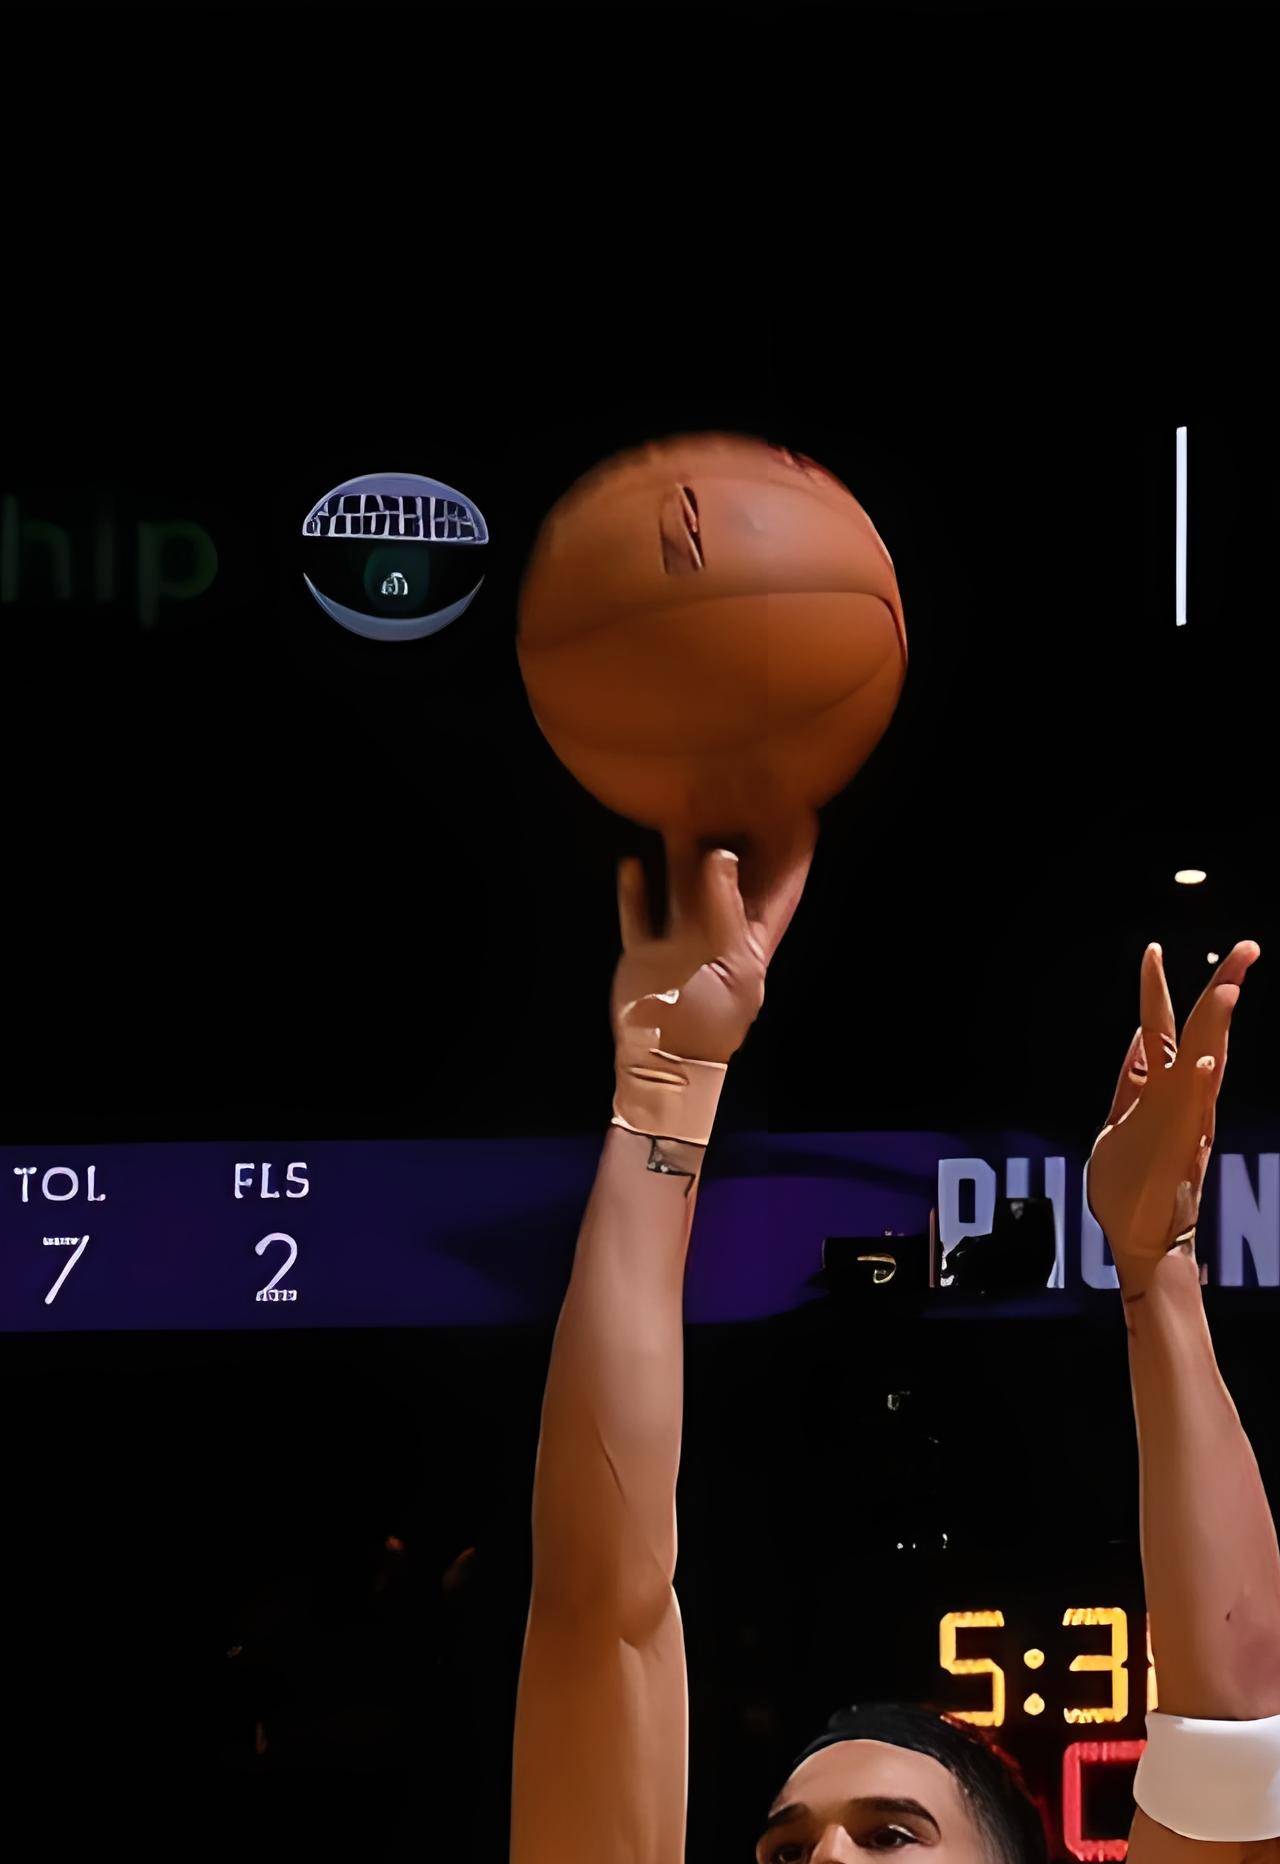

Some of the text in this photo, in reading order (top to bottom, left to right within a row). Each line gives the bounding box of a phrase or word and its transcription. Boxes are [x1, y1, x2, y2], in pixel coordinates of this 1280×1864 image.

[13, 1164, 107, 1203] TOL
[234, 1161, 310, 1200] FLS
[42, 1234, 90, 1305] 7
[254, 1232, 298, 1302] 2
[938, 1605, 1159, 1729] 5:3
